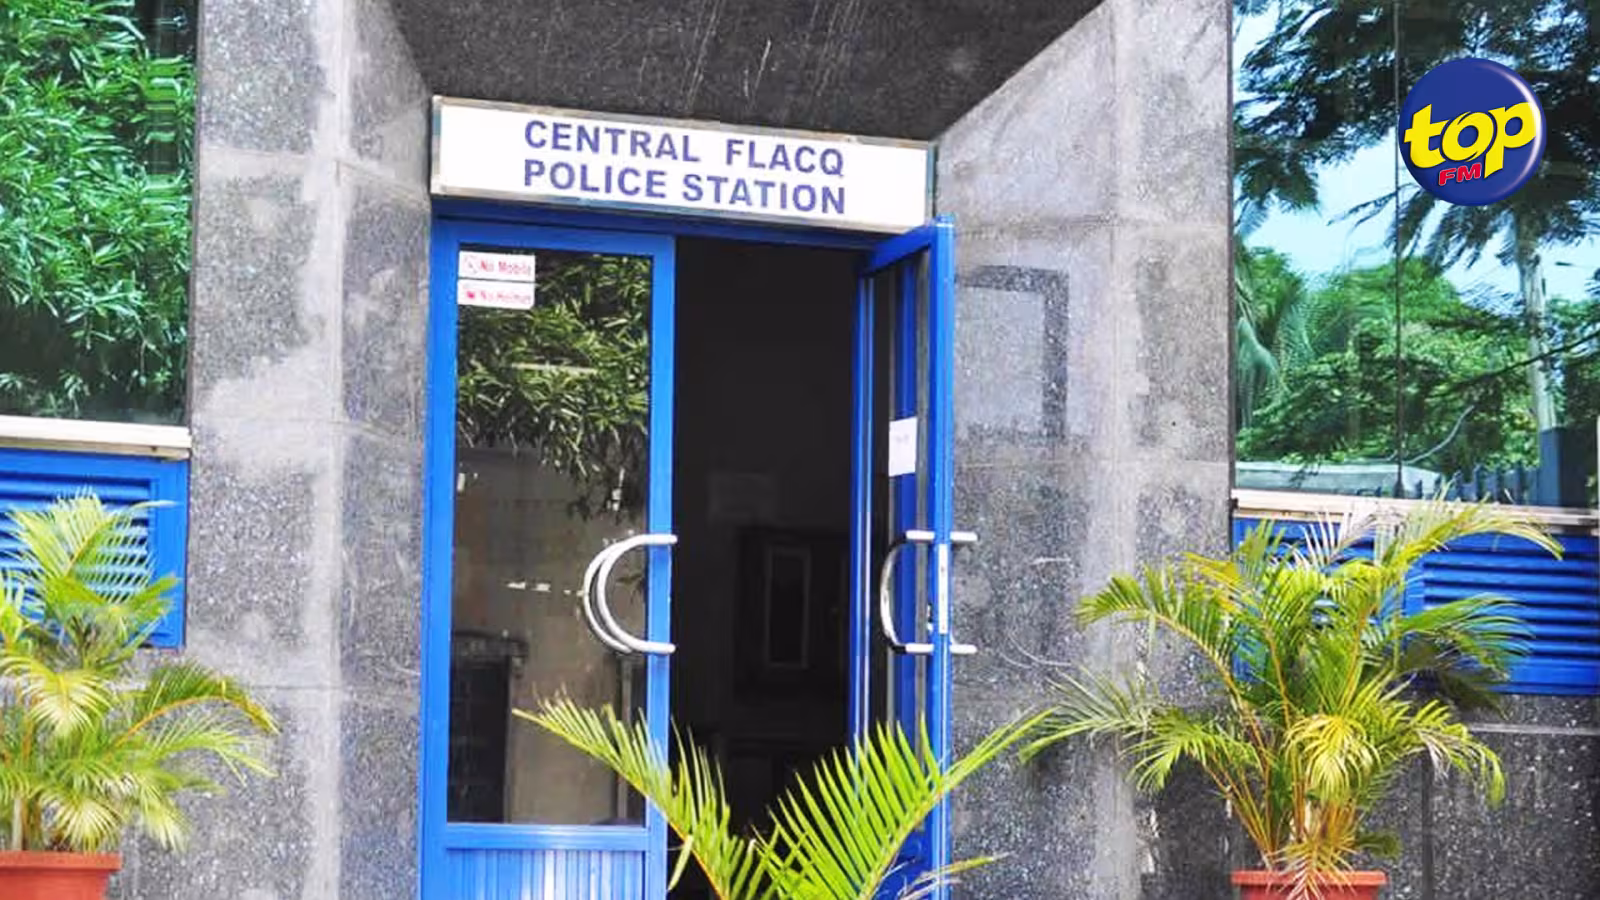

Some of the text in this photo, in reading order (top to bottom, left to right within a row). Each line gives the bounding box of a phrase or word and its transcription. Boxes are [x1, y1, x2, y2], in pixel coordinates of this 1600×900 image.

[524, 120, 845, 178] CENTRAL FLACQ
[523, 159, 846, 214] POLICE STATION
